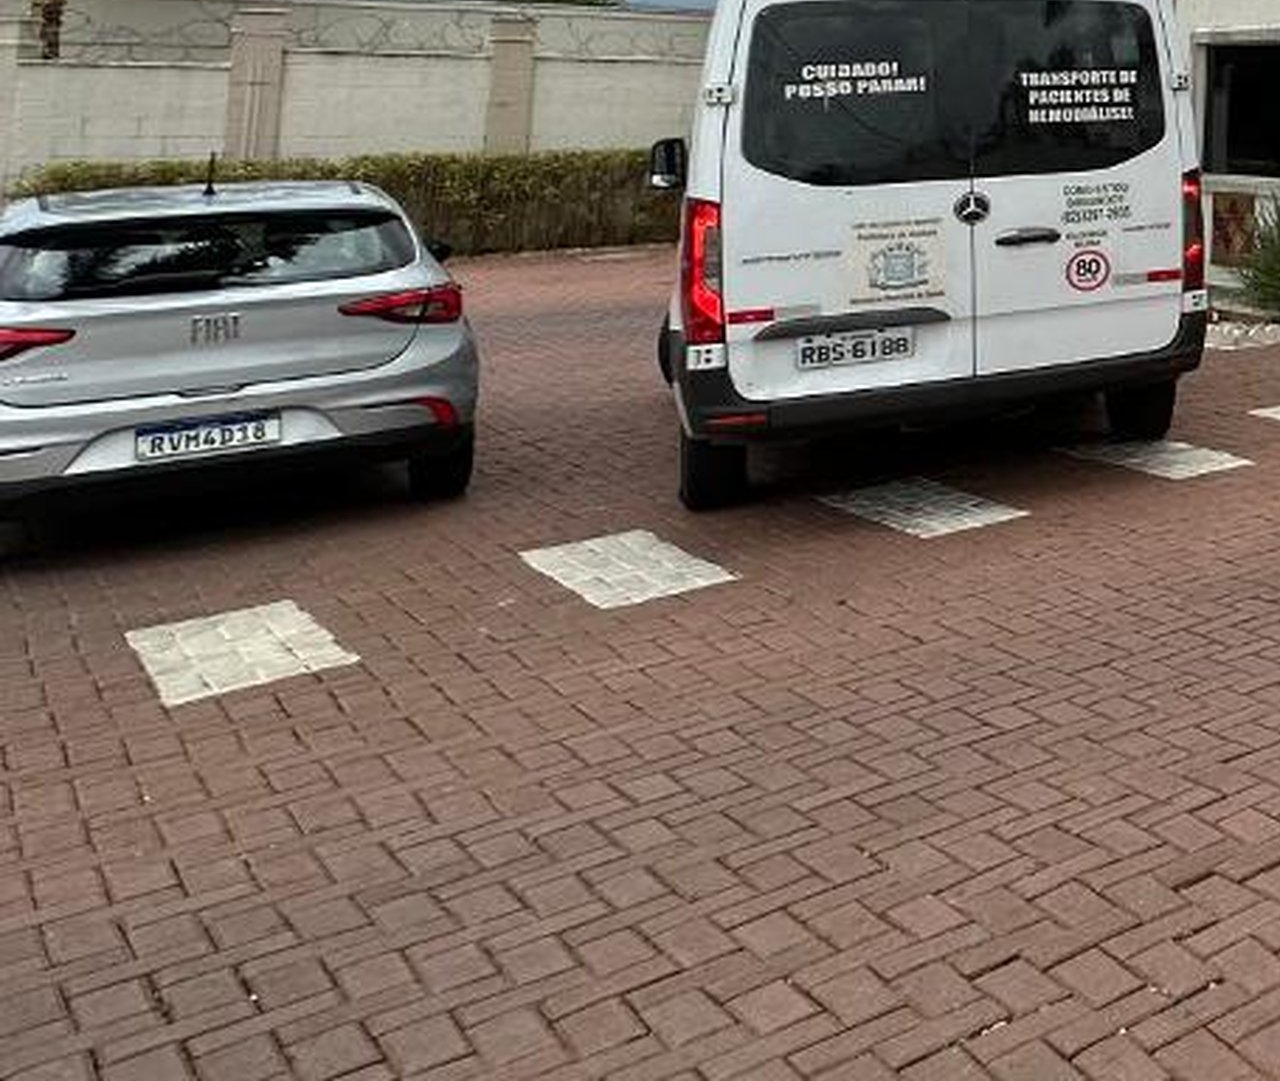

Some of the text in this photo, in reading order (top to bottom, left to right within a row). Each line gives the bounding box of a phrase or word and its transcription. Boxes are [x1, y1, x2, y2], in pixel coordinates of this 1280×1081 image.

[801, 61, 899, 80] CUIDADO!
[1020, 70, 1138, 87] TRANSPORTE DE
[784, 76, 926, 100] POSSO PARAR!
[1028, 86, 1131, 105] PACIENTES DE
[1076, 257, 1101, 277] 80
[190, 316, 240, 344] FIAT
[149, 421, 267, 454] RVM4D18
